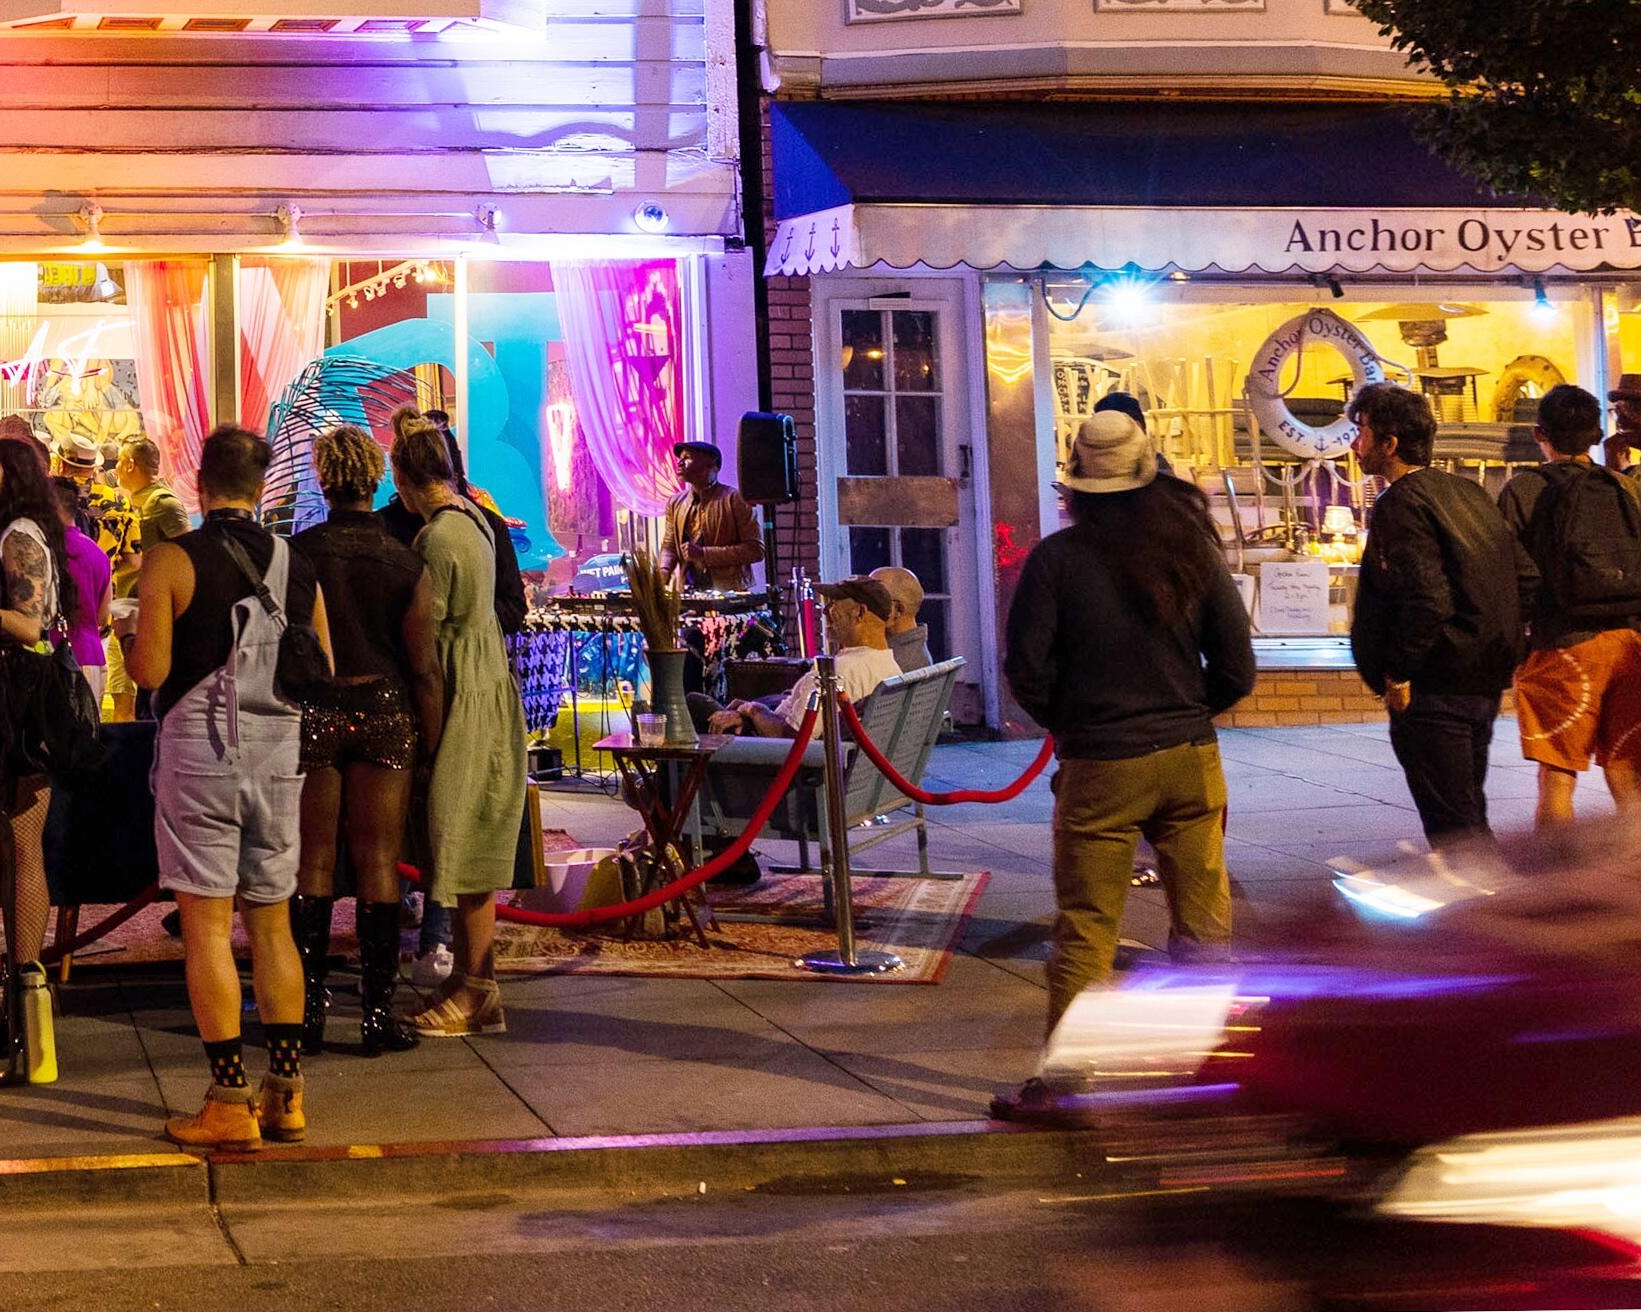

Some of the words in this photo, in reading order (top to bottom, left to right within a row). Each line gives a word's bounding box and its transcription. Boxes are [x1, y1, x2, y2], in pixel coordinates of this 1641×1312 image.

[1285, 218, 1445, 252] Anchor
[1457, 219, 1611, 261] Oyster
[1258, 328, 1303, 382] Anchor
[1310, 317, 1364, 350] Oyster
[602, 565, 624, 577] PAIN
